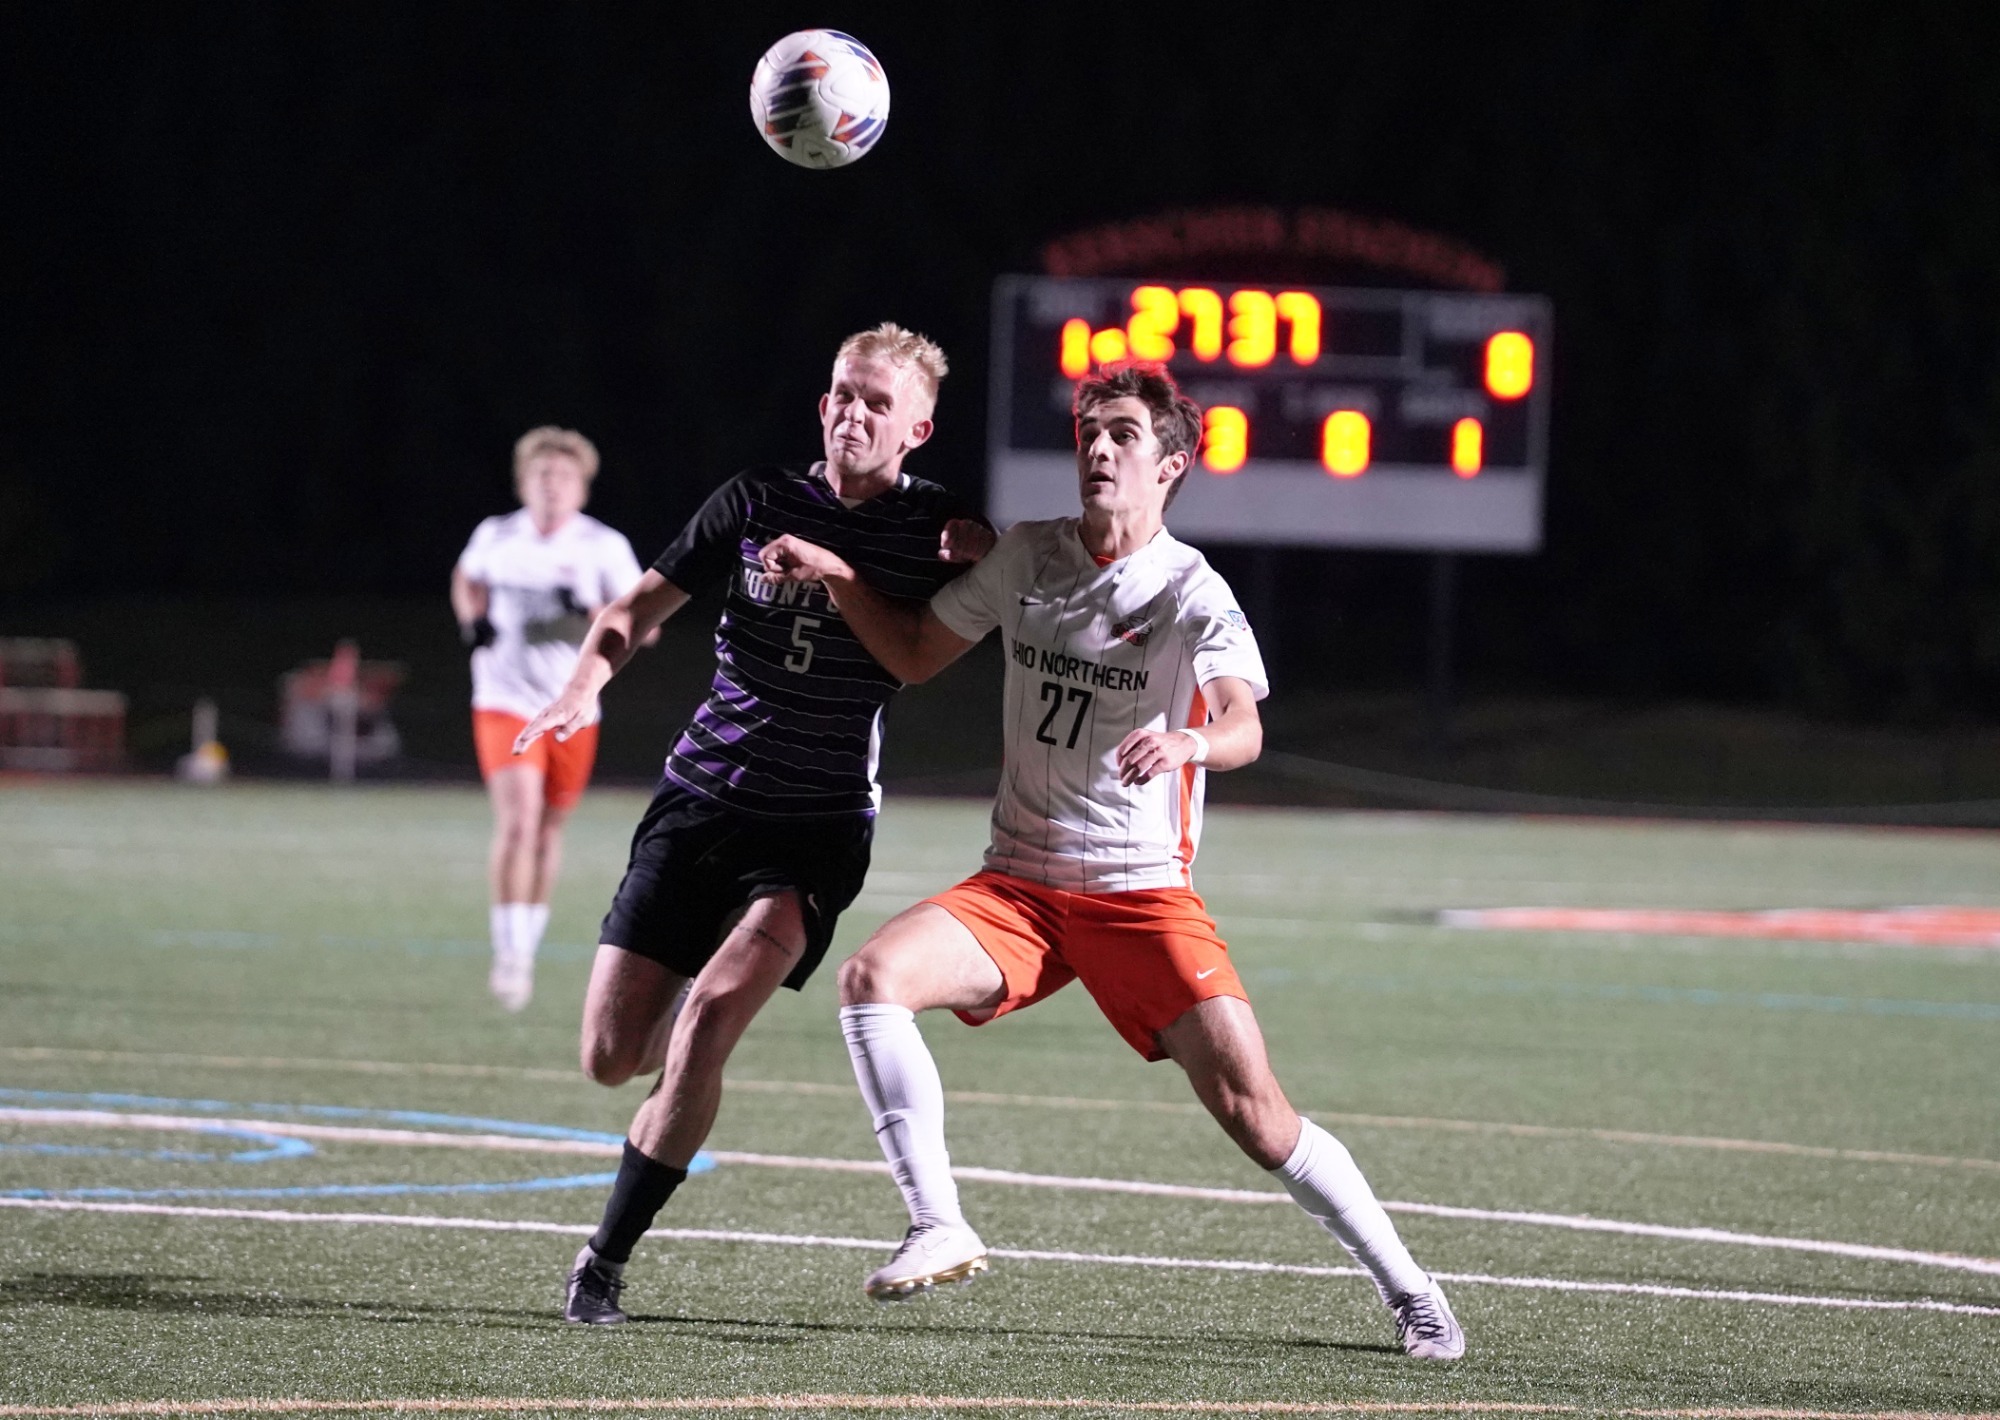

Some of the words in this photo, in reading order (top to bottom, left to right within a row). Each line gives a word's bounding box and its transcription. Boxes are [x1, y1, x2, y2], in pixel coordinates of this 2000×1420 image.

[784, 616, 821, 674] 5
[1040, 649, 1149, 691] NORTHERN
[1036, 681, 1093, 750] 27
